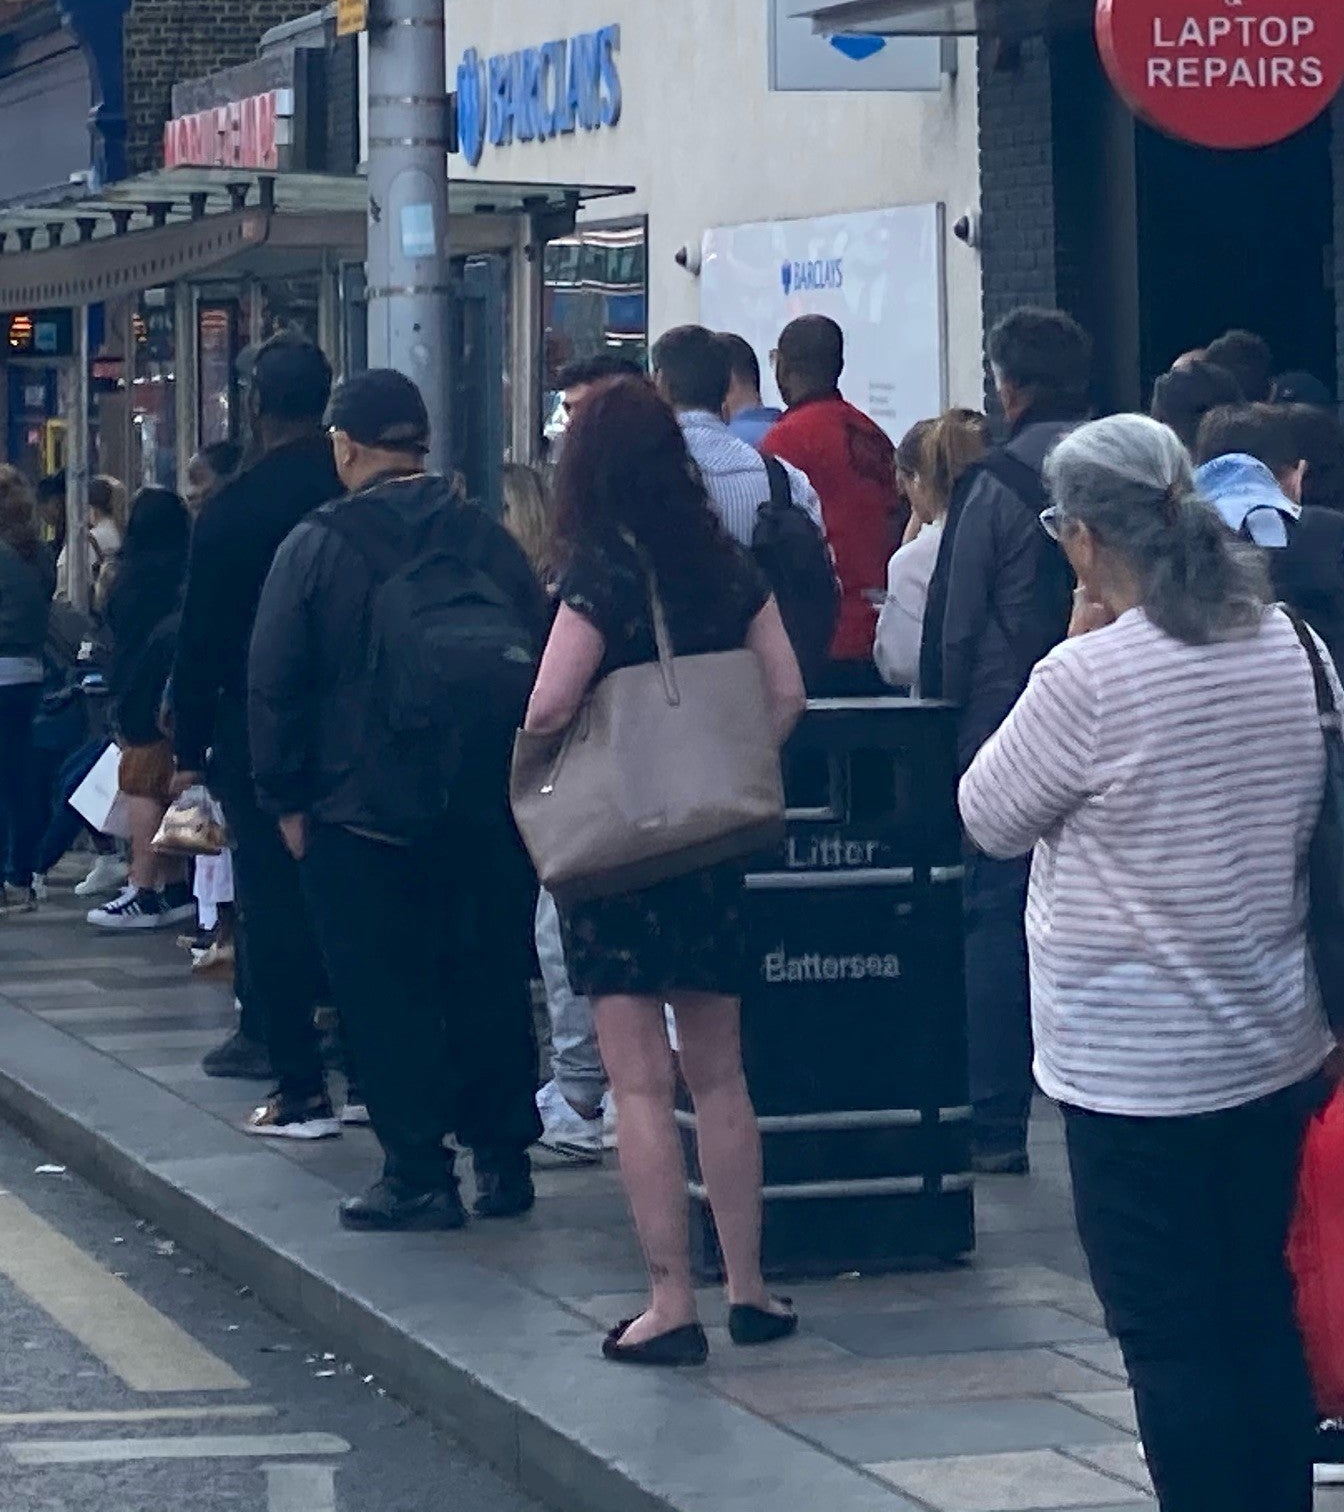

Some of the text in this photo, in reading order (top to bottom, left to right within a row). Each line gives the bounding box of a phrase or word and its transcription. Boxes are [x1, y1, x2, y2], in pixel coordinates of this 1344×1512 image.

[1153, 16, 1315, 48] LAPTOP
[1147, 56, 1324, 88] REPAIRS
[794, 258, 844, 291] BARCLAYS
[786, 834, 880, 867] Litter
[763, 950, 902, 983] Battersea
